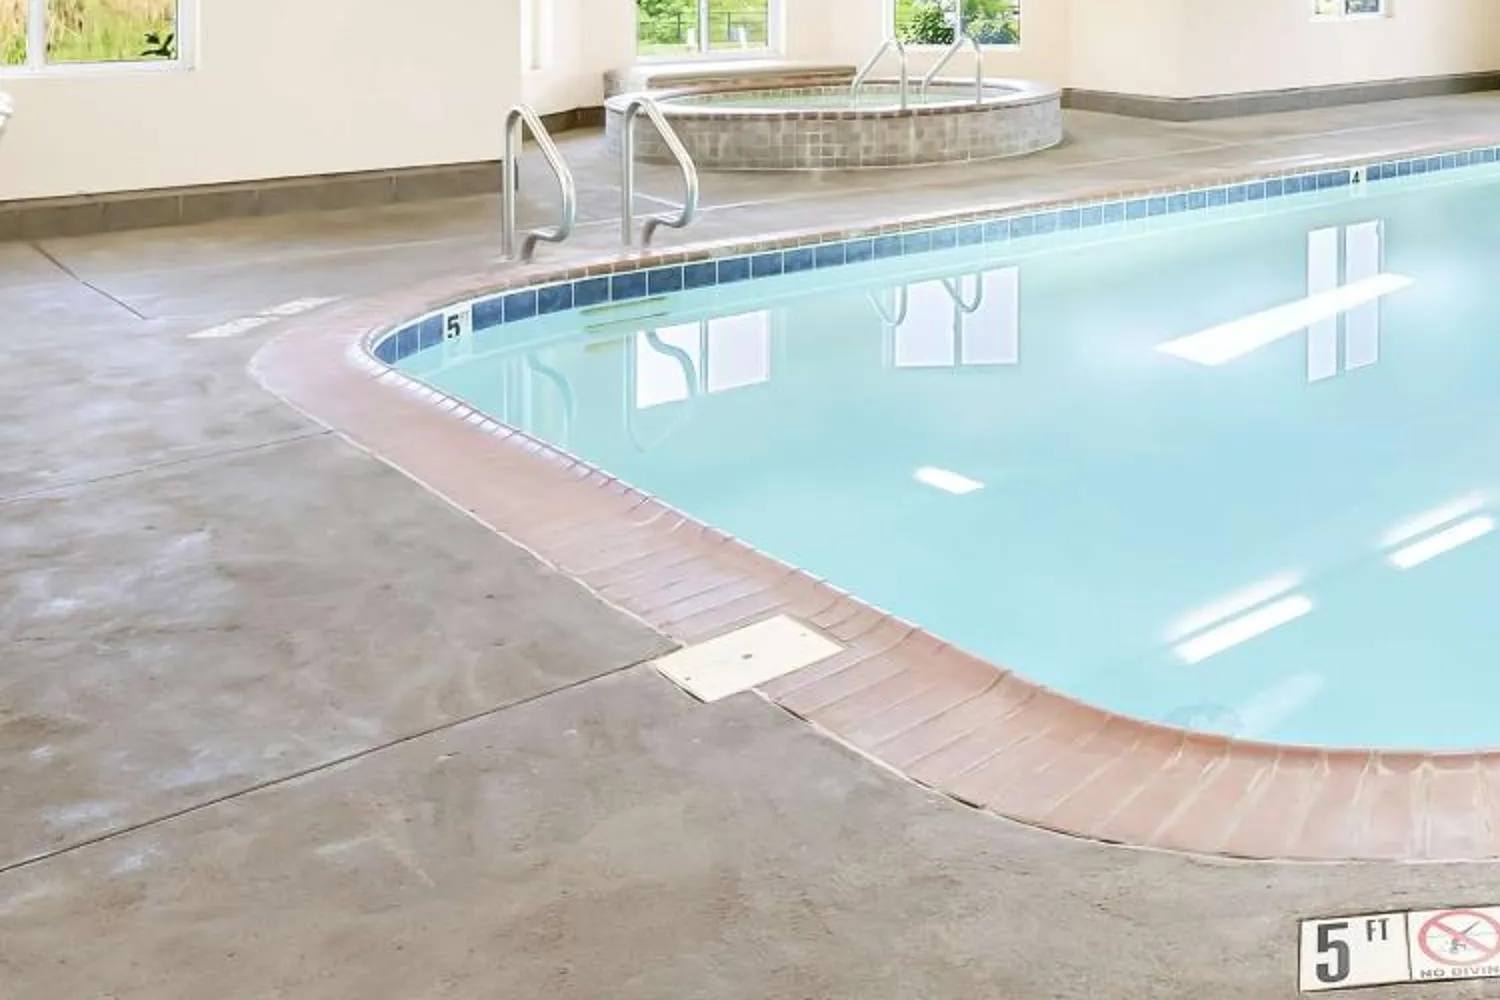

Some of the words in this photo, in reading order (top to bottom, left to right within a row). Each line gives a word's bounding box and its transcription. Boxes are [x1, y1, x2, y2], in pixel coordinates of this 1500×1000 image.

[447, 313, 460, 339] 5
[1315, 922, 1350, 983] 5
[1366, 918, 1389, 942] FT
[1419, 966, 1445, 979] NO
